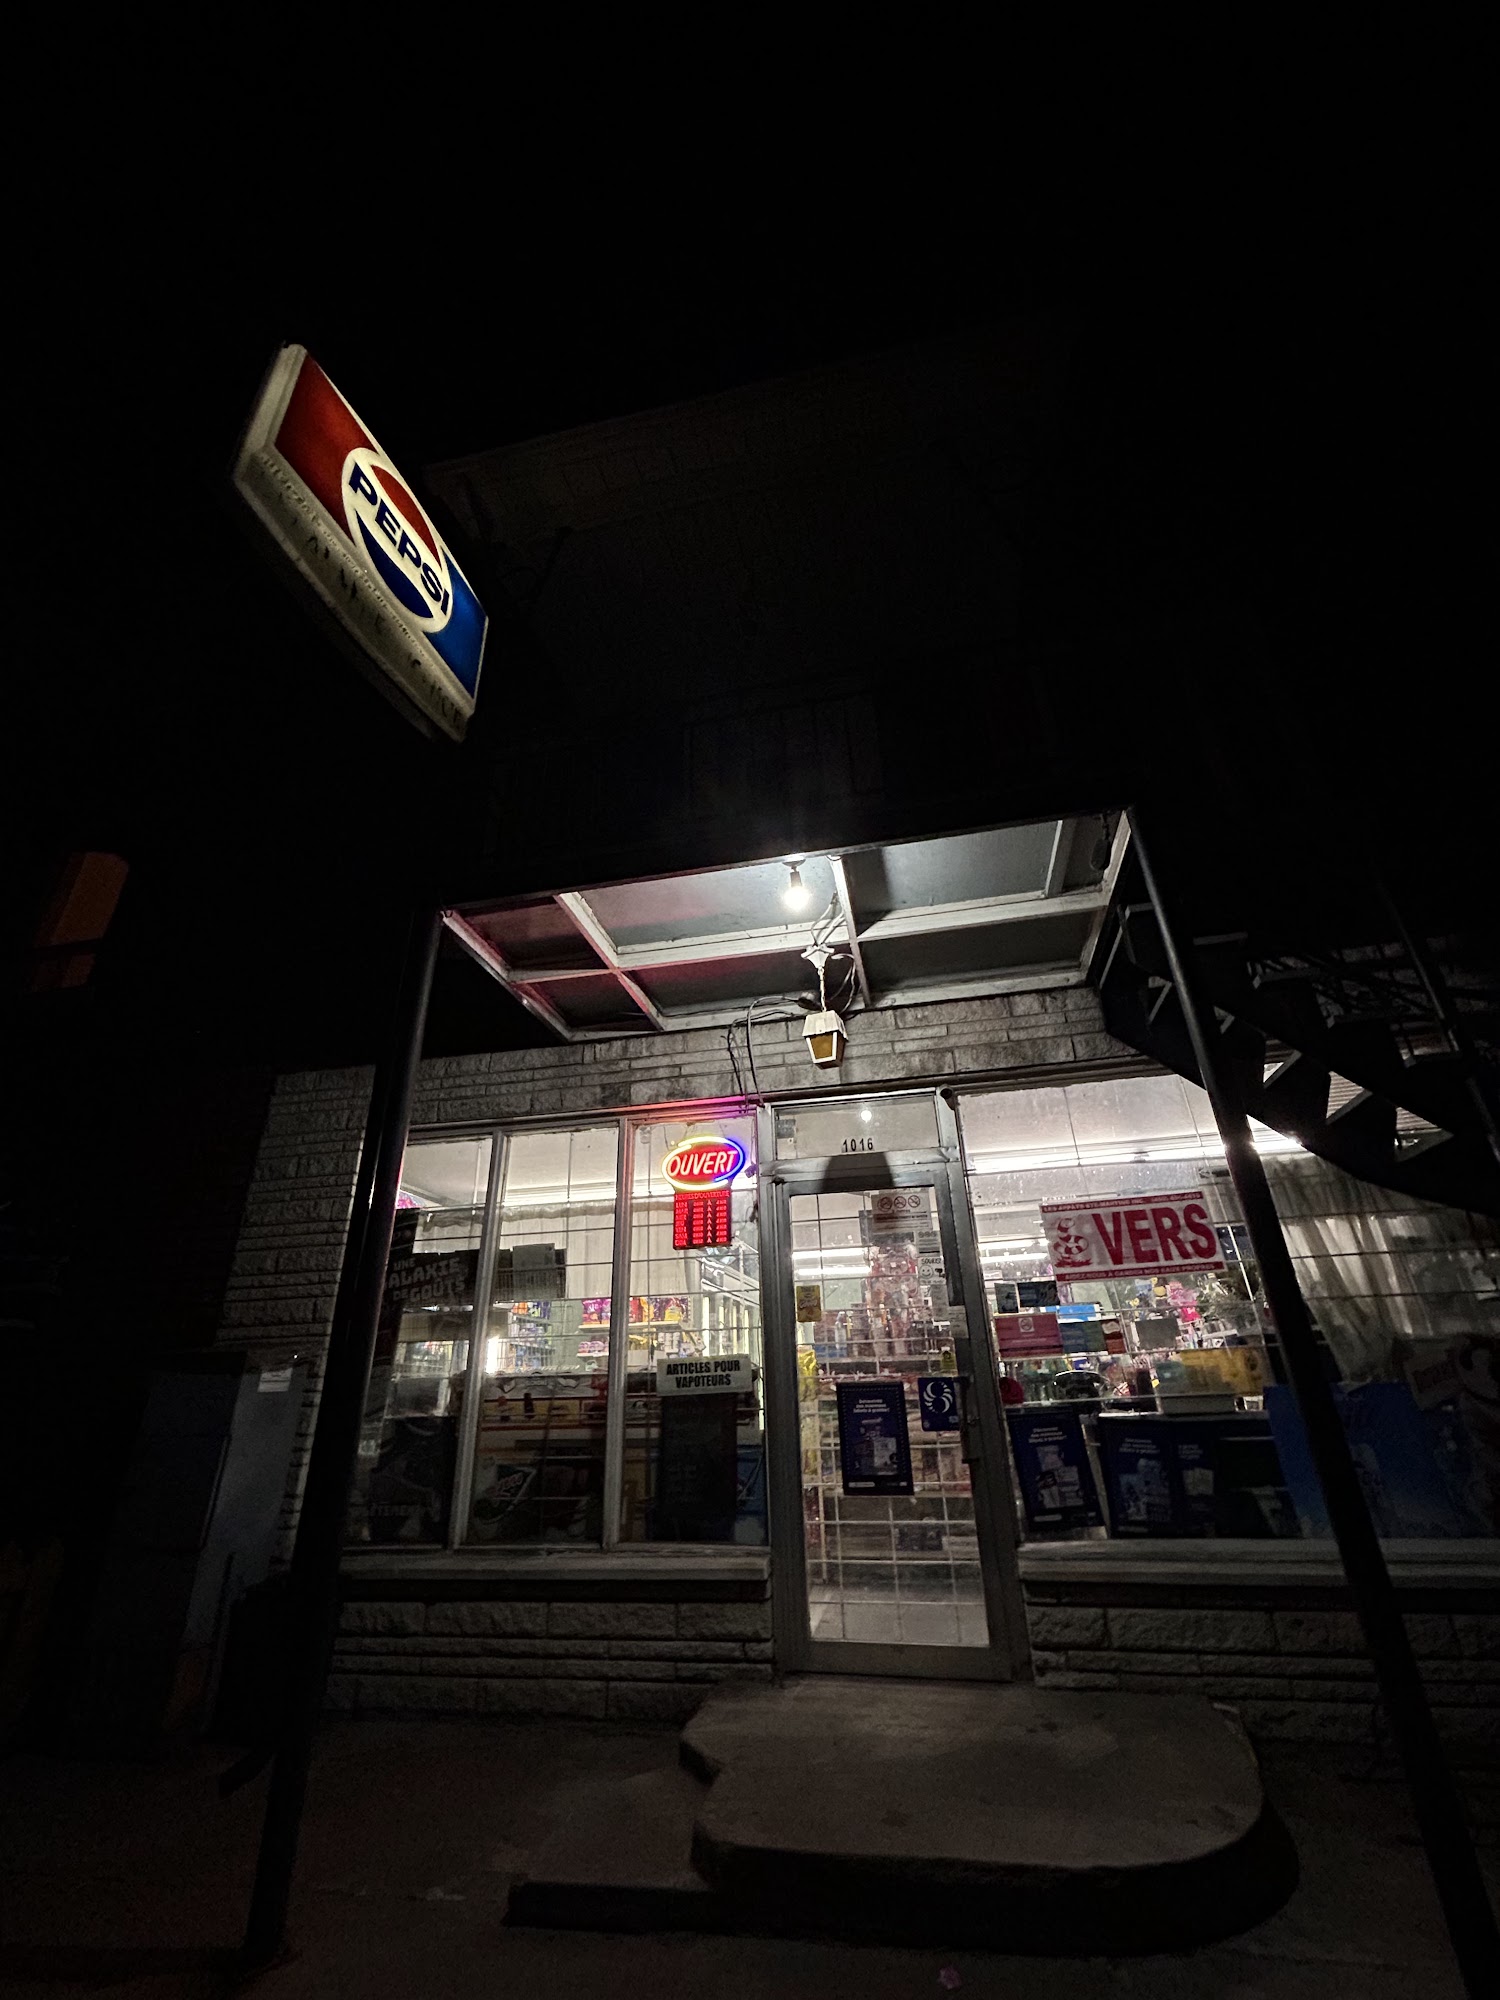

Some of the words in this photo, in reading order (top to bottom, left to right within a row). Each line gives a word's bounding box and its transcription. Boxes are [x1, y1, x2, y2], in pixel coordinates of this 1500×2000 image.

[349, 462, 450, 616] PEPSI
[843, 1138, 874, 1152] 1016
[667, 1151, 739, 1176] OUVERT
[1091, 1203, 1217, 1266] VERS
[388, 1257, 461, 1289] ALAXIE
[666, 1362, 711, 1375] ARTICLES
[714, 1360, 740, 1372] POUR
[675, 1374, 731, 1388] VAPOTEURS
